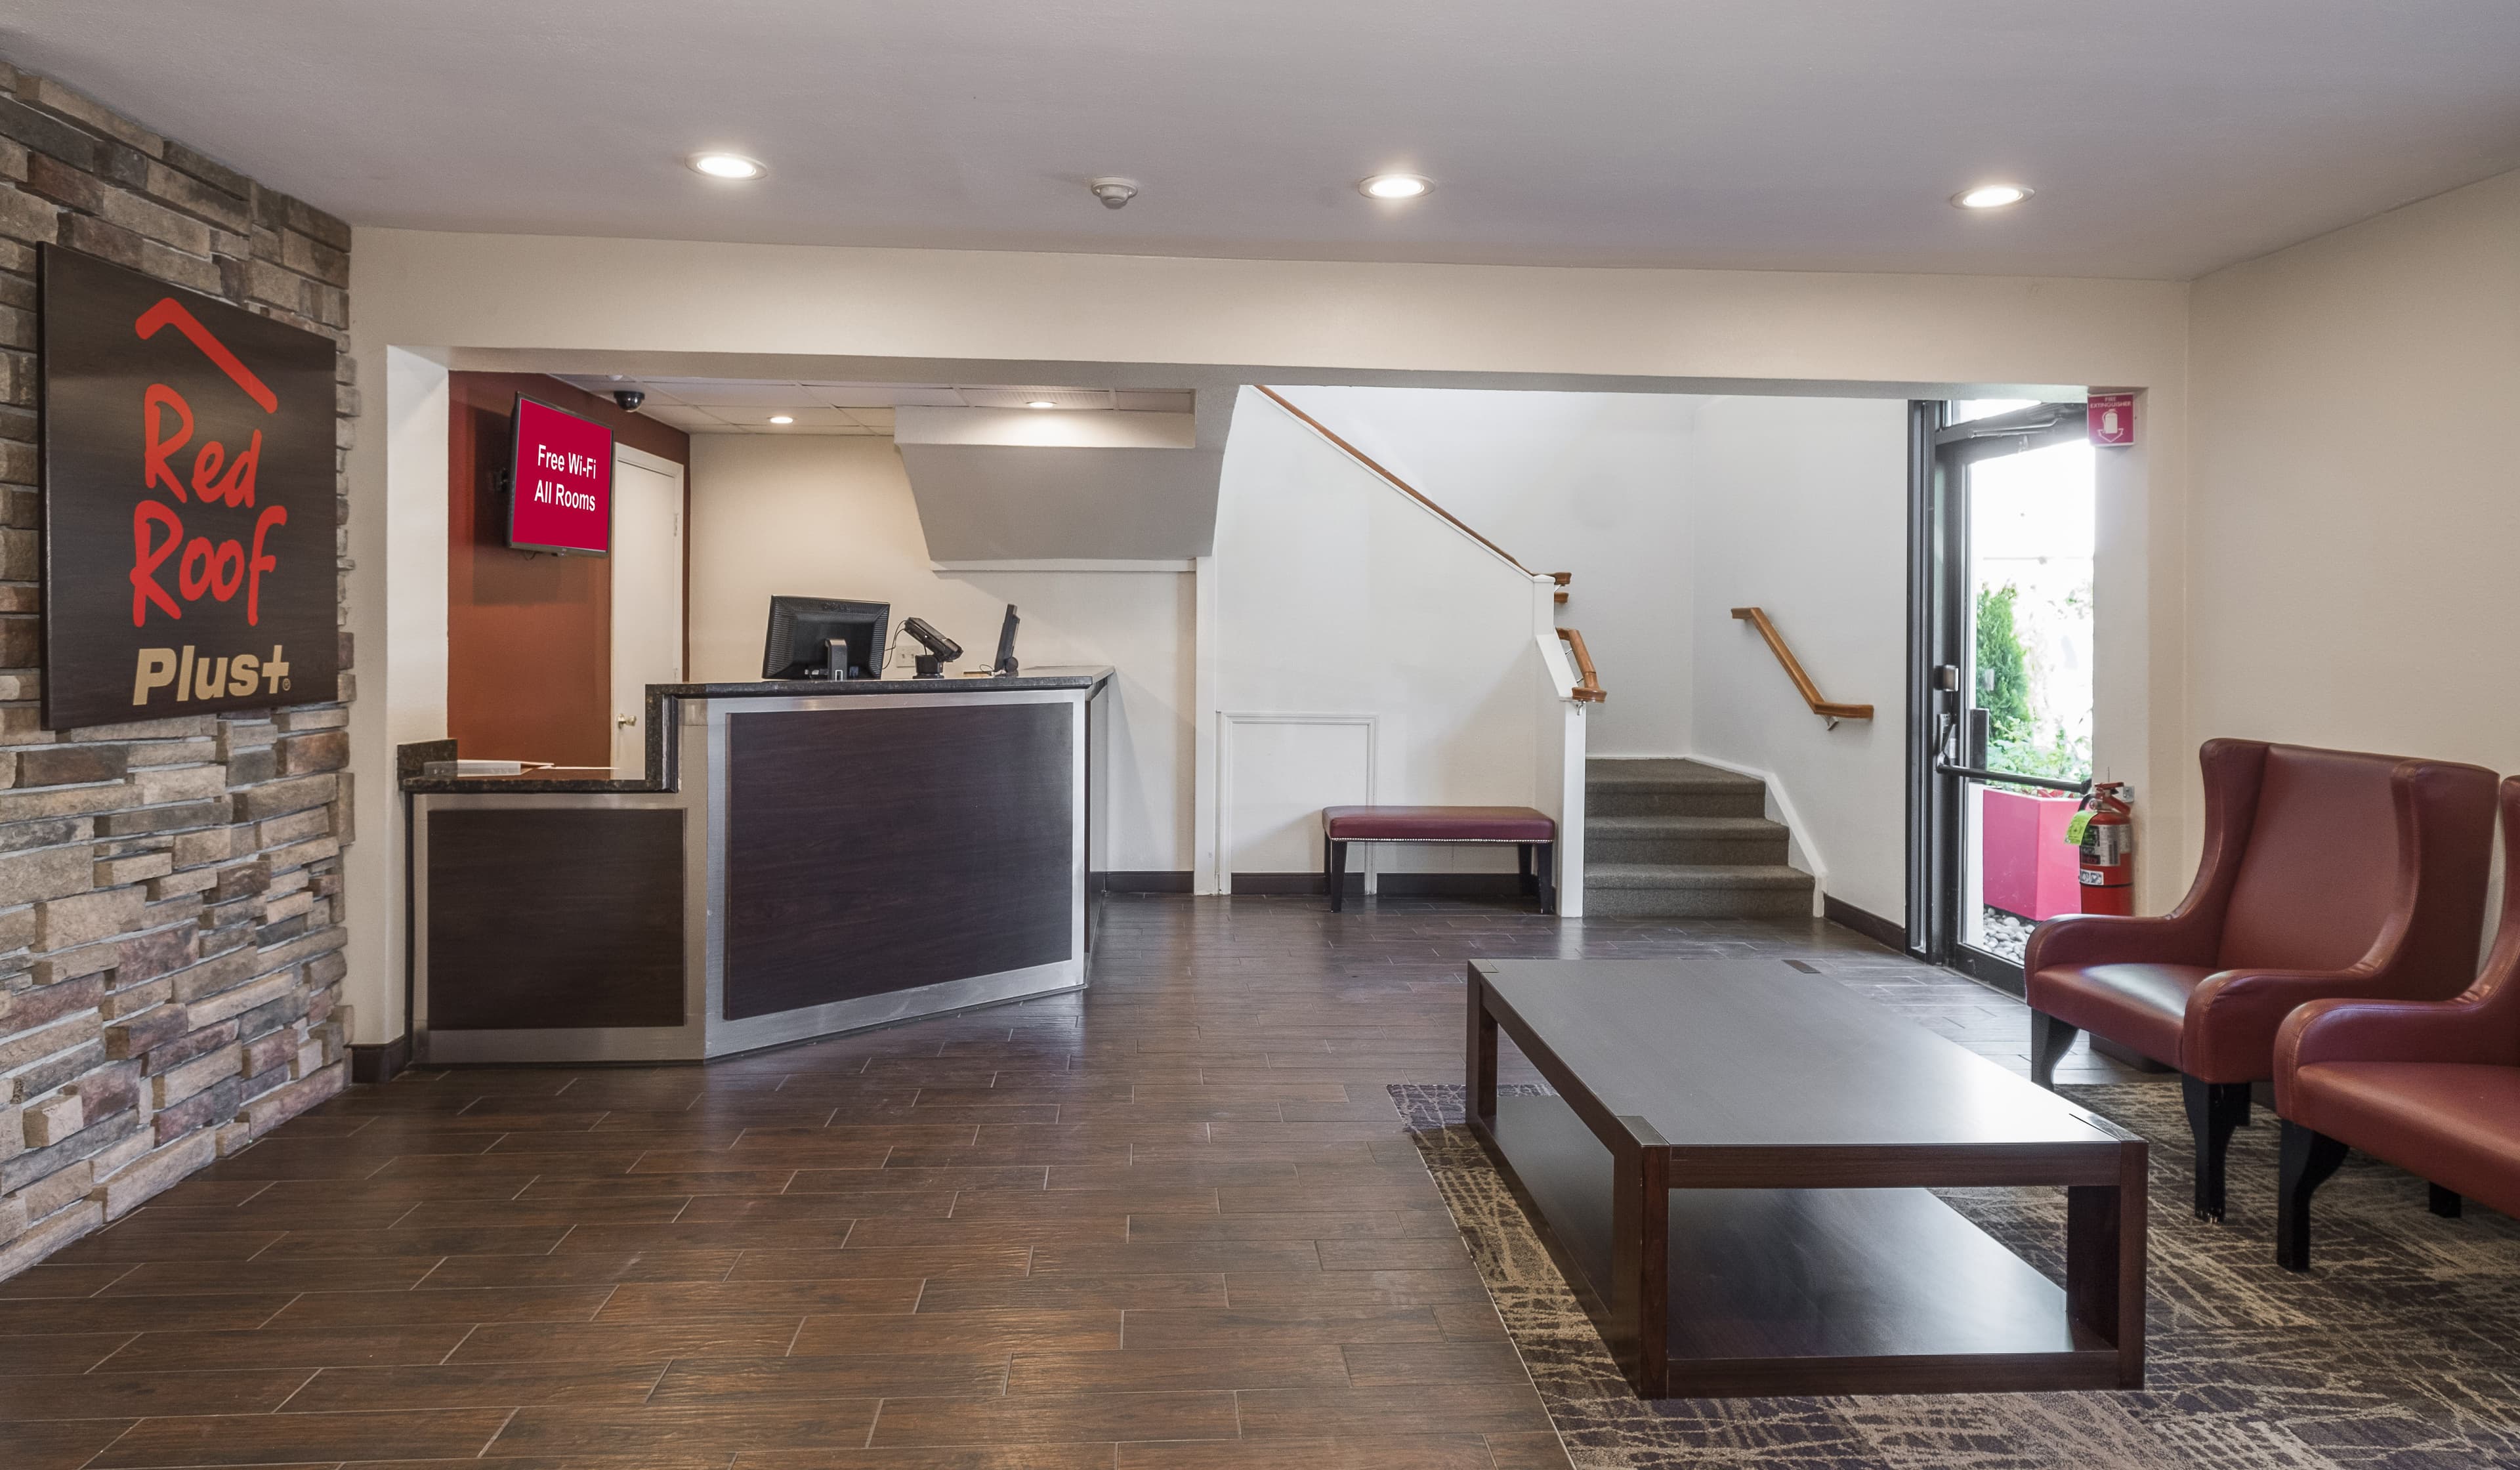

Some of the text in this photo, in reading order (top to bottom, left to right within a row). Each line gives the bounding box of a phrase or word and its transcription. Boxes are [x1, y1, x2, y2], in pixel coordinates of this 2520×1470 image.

[144, 384, 261, 507] Red
[537, 444, 597, 479] Free Wi-Fi
[534, 480, 596, 512] All Rooms
[130, 500, 287, 627] Roof
